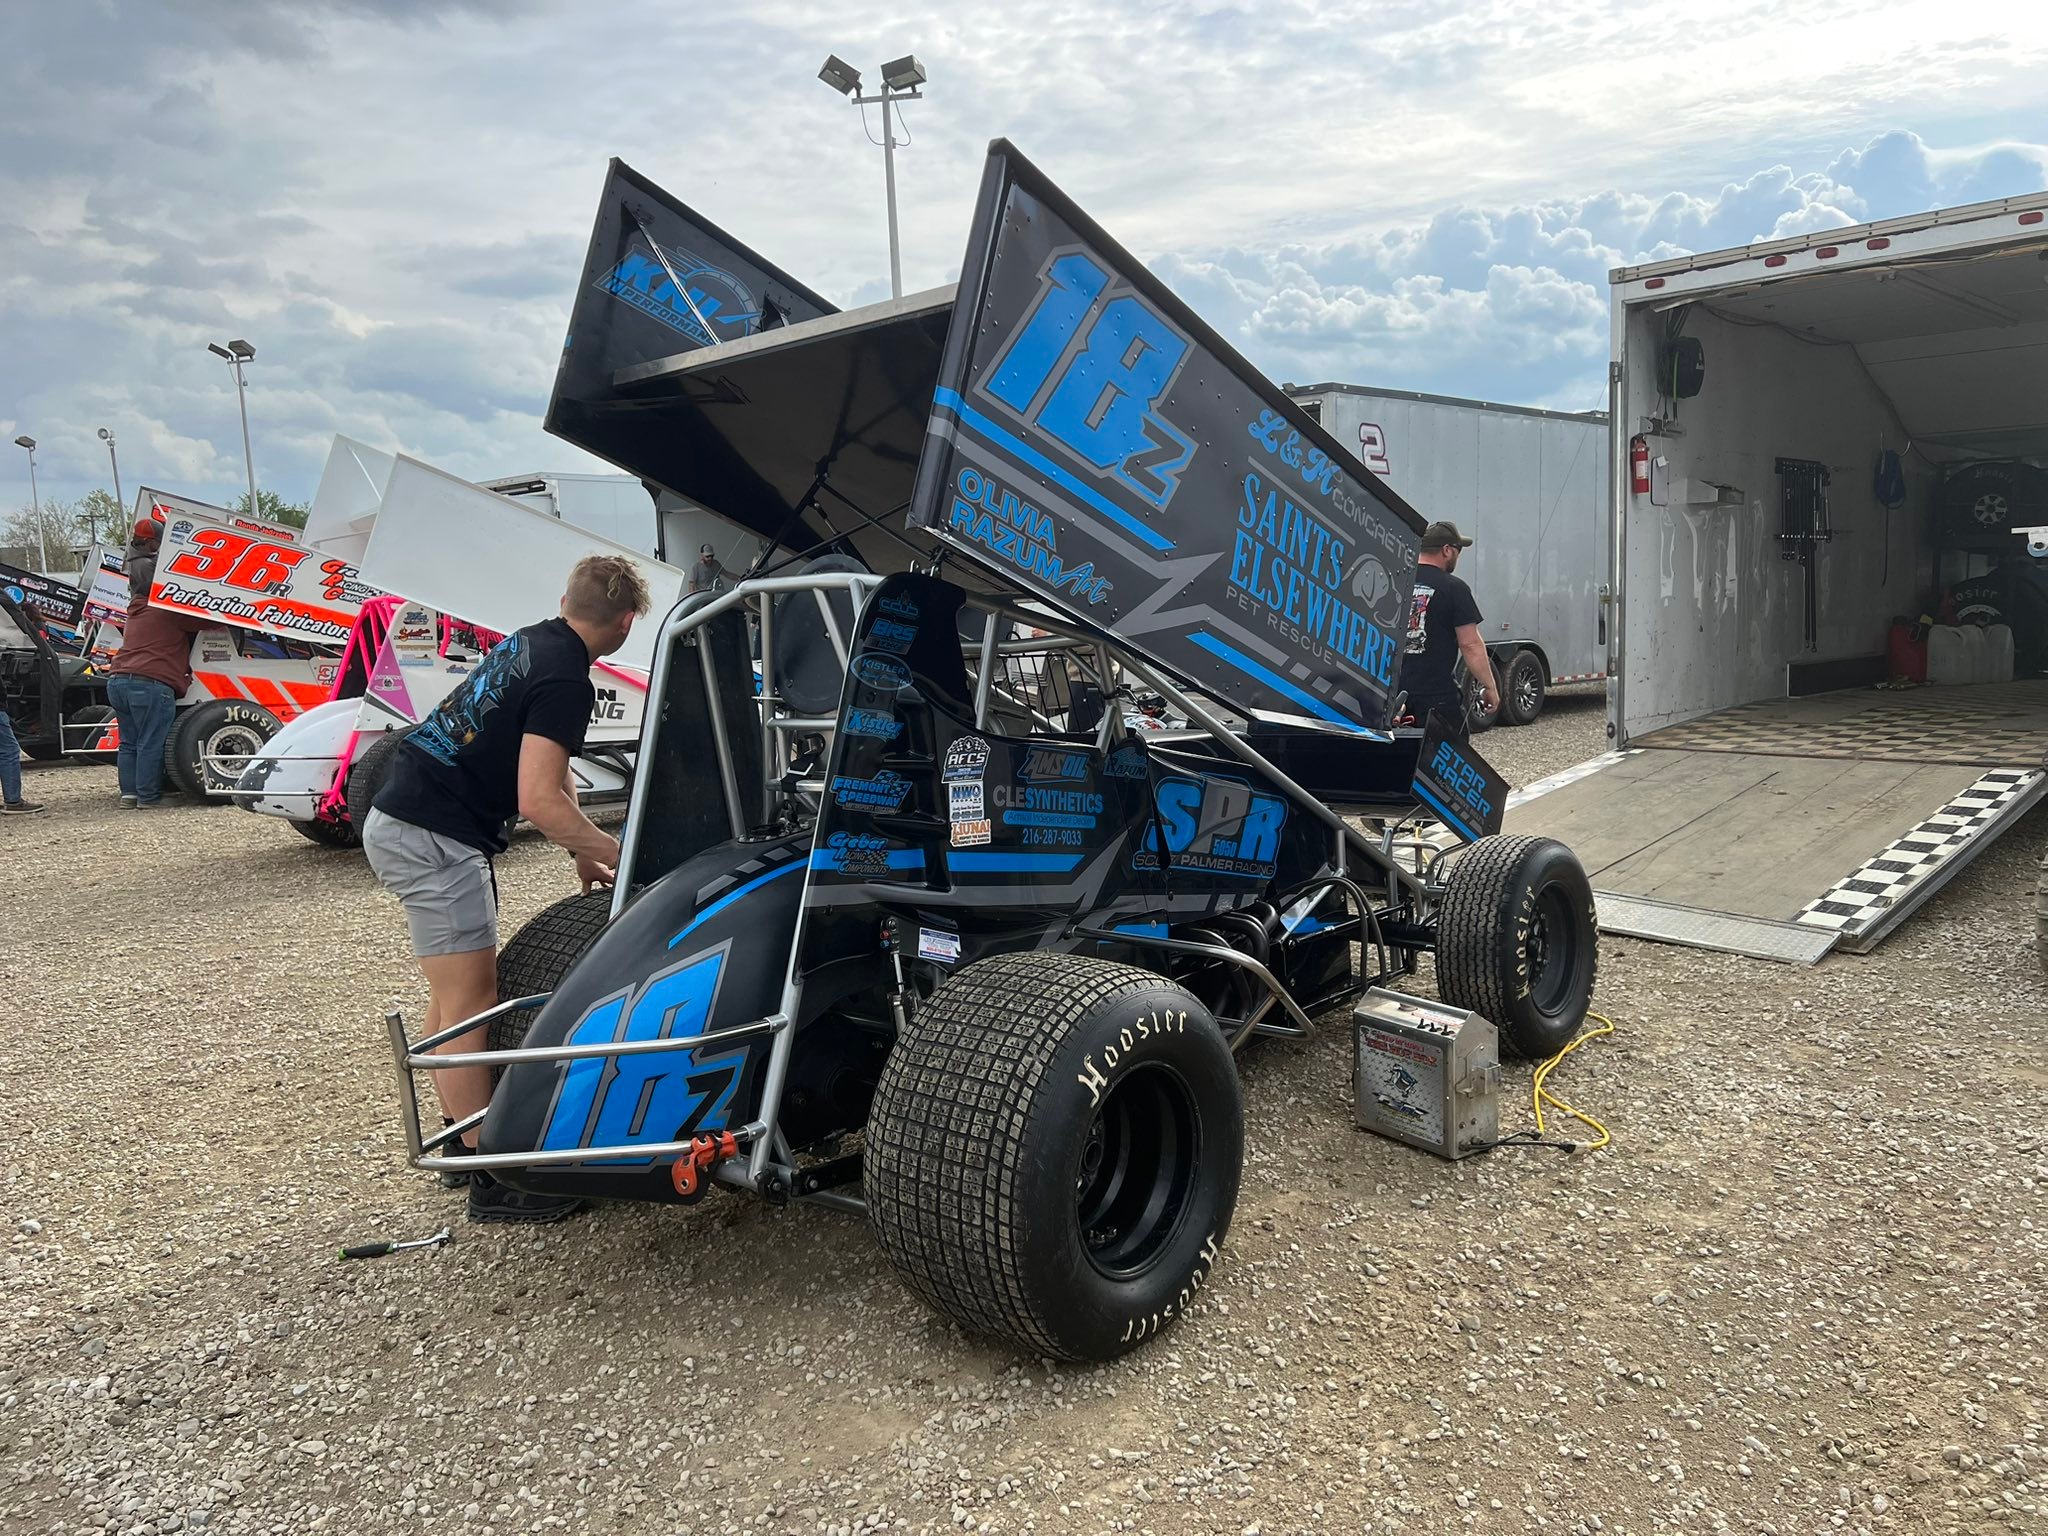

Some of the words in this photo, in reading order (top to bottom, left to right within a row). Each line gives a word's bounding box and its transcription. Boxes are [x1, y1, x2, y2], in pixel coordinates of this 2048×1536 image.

[1359, 422, 1390, 475] 2
[958, 467, 1056, 552] OLIVIA
[1239, 472, 1344, 592] SAINTS
[1332, 487, 1416, 569] CONCRETE
[950, 495, 1064, 585] RAZUM
[26, 598, 71, 615] WEALTH
[27, 592, 73, 610] STRUCTURED
[159, 582, 256, 618] Perfection
[259, 605, 352, 639] Fabricators
[1226, 586, 1261, 616] PET
[1268, 613, 1332, 665] RESCUE
[1229, 528, 1396, 687] ELSEWHERE
[862, 660, 906, 675] KISTLER
[849, 711, 904, 733] Kistler
[948, 753, 986, 765] AFCS
[1023, 751, 1090, 779] AMSOIL
[1439, 741, 1486, 793] STAR
[833, 777, 891, 794] FREMONT
[838, 790, 899, 806] SPEEDWAY
[1431, 755, 1493, 817] RACER
[1023, 828, 1082, 845] 216-287-9033
[1147, 780, 1284, 862] SPR
[840, 861, 887, 873] COMPONENTS
[1181, 855, 1233, 870] PALMER
[1235, 861, 1274, 875] RACING
[1078, 1009, 1189, 1108] Hoosier
[1121, 1232, 1220, 1342] Hoosier
